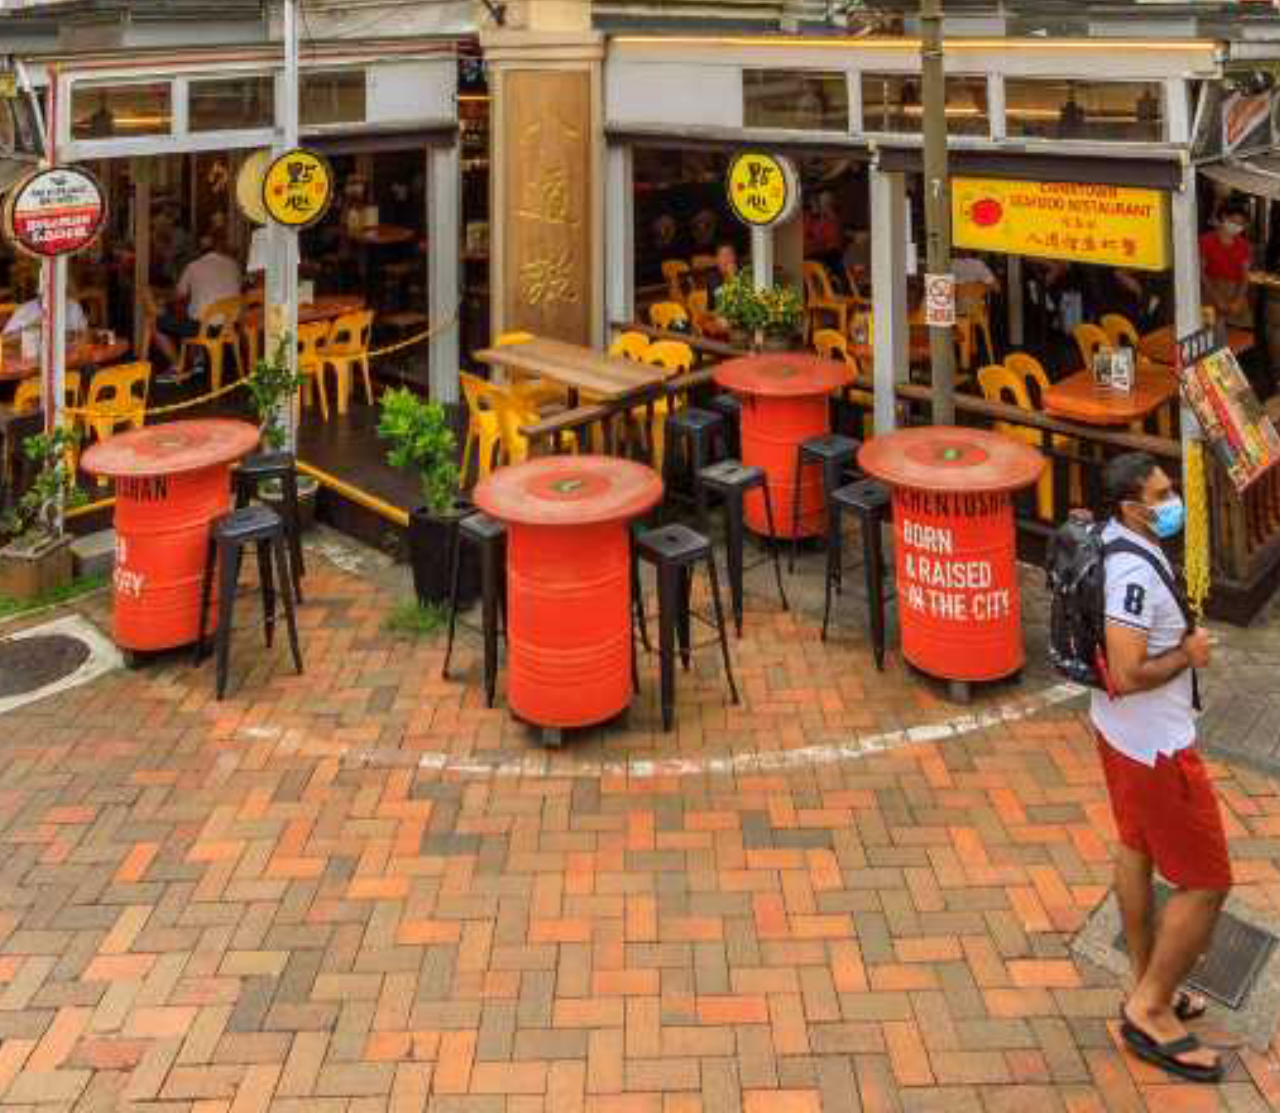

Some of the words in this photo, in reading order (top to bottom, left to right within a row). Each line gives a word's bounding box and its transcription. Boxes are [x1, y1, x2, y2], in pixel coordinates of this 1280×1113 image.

[903, 519, 952, 553] BORN
[926, 589, 969, 620] THE
[972, 590, 1010, 622] CITY
[1123, 582, 1146, 616] 8
